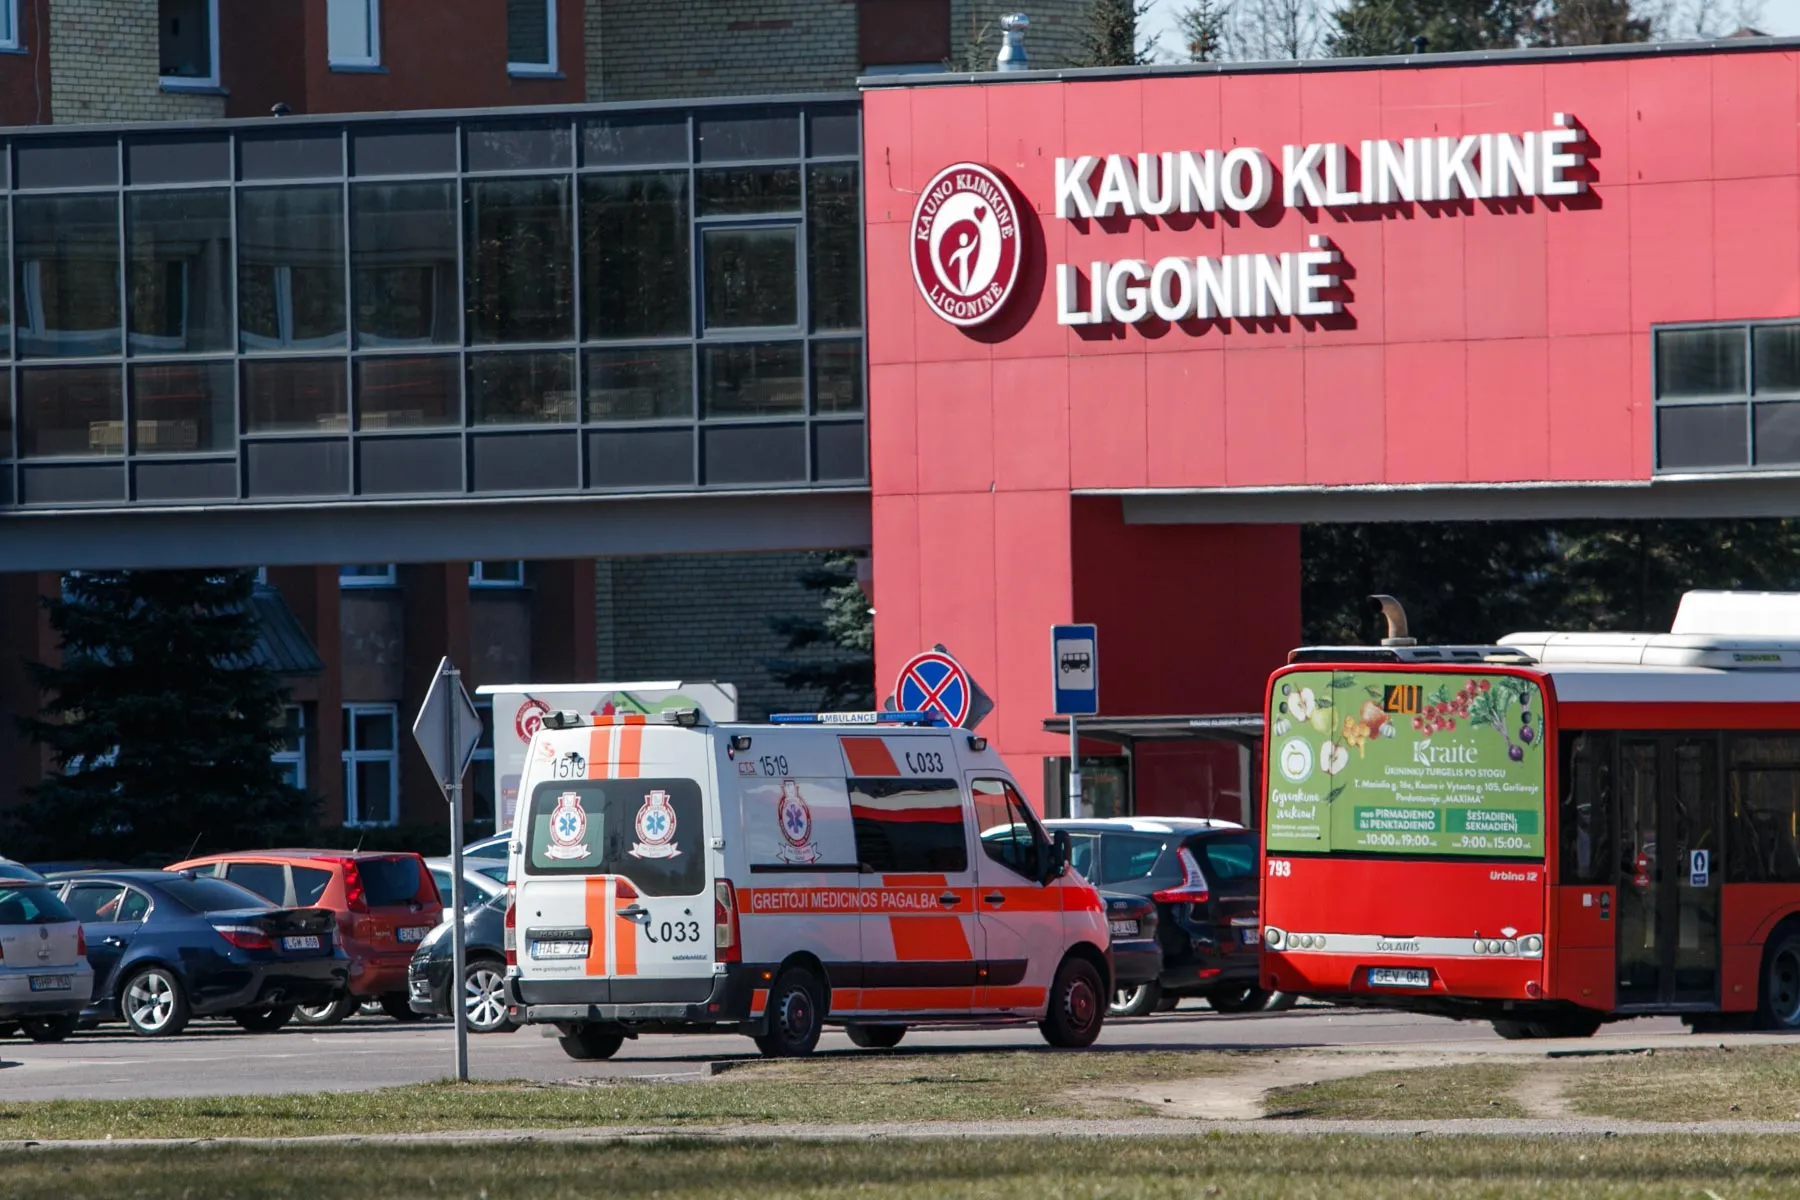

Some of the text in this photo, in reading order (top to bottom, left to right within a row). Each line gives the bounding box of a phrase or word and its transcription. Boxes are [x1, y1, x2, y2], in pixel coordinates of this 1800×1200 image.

[1055, 112, 1587, 218] KAUNO KLINIKINĖ
[917, 173, 1014, 241] KAUNO KLINIKINĖ
[1056, 234, 1342, 325] LIGONINĖ
[929, 281, 1004, 317] LIGONINĖ
[1387, 685, 1418, 714] 40
[819, 713, 876, 723] AMBULANCE
[1413, 738, 1478, 767] Kraitė
[550, 757, 586, 779] 1519
[759, 755, 789, 776] 1519
[916, 752, 944, 774] 033
[1464, 768, 1477, 777] PO
[1477, 768, 1507, 778] STOGU
[1375, 808, 1435, 820] PIRMADIENIO
[1370, 819, 1436, 830] PENKTADIENIO
[1465, 821, 1518, 833] SEKMADIENĮ
[1366, 833, 1396, 846] 10:00
[1401, 834, 1430, 847] 19:00
[1461, 835, 1487, 849] 9:00
[1493, 836, 1523, 849] 15:00
[1268, 860, 1291, 878] 793
[1489, 871, 1538, 882] Urbino 12
[753, 891, 938, 909] GREITOJI MEDICINOS PAGALBA
[660, 921, 701, 943] 033
[538, 941, 587, 955] HAE 724
[1376, 941, 1420, 952] SOLARIS
[1375, 969, 1428, 984] GEV 064
